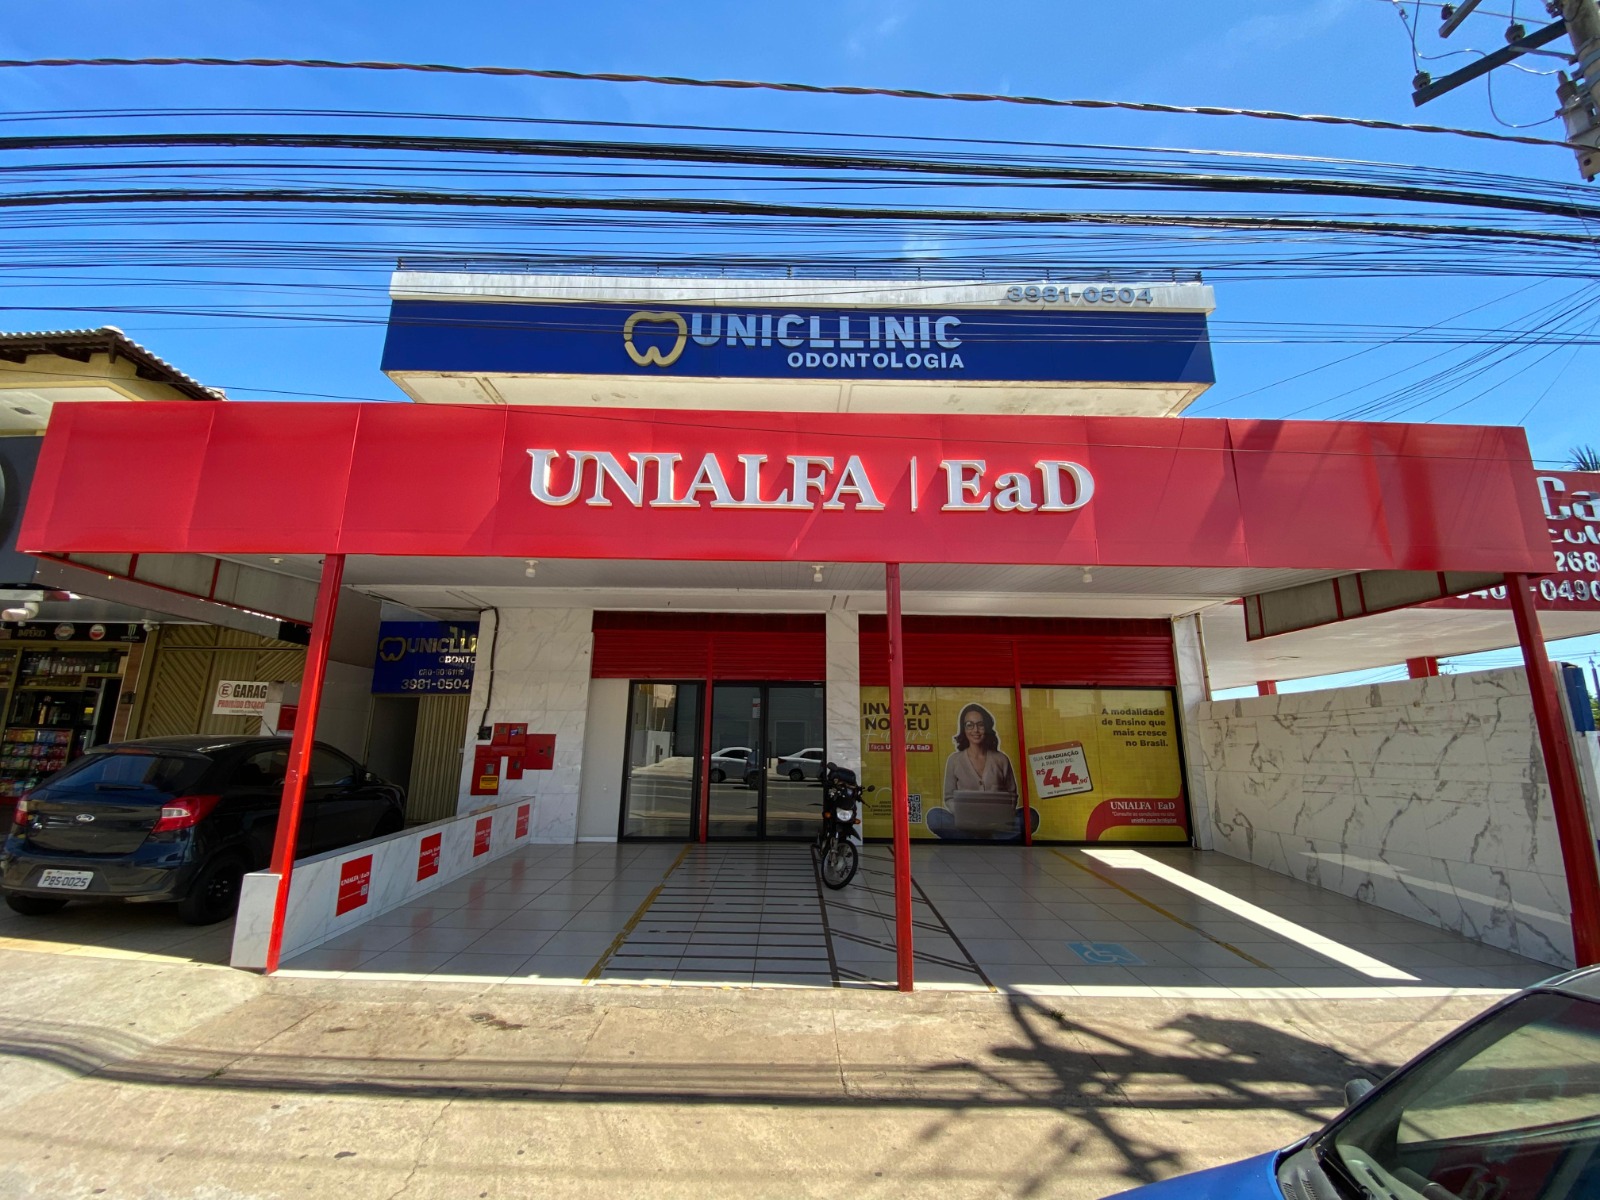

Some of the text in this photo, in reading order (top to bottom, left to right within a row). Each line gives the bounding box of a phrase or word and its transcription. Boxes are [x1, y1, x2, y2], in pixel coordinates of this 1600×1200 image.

[1006, 285, 1153, 304] 3981-0504
[691, 313, 963, 349] UNICLLINIC
[787, 352, 965, 369] ODONTOLOGIA
[526, 448, 1096, 512] UNIALFA EaD
[401, 678, 470, 690] 3981-0504
[1101, 708, 1165, 716] A modalidade
[1115, 718, 1146, 726] Ensino
[1140, 739, 1168, 747] Brasil.
[1110, 801, 1175, 810] UNIALFA EaD
